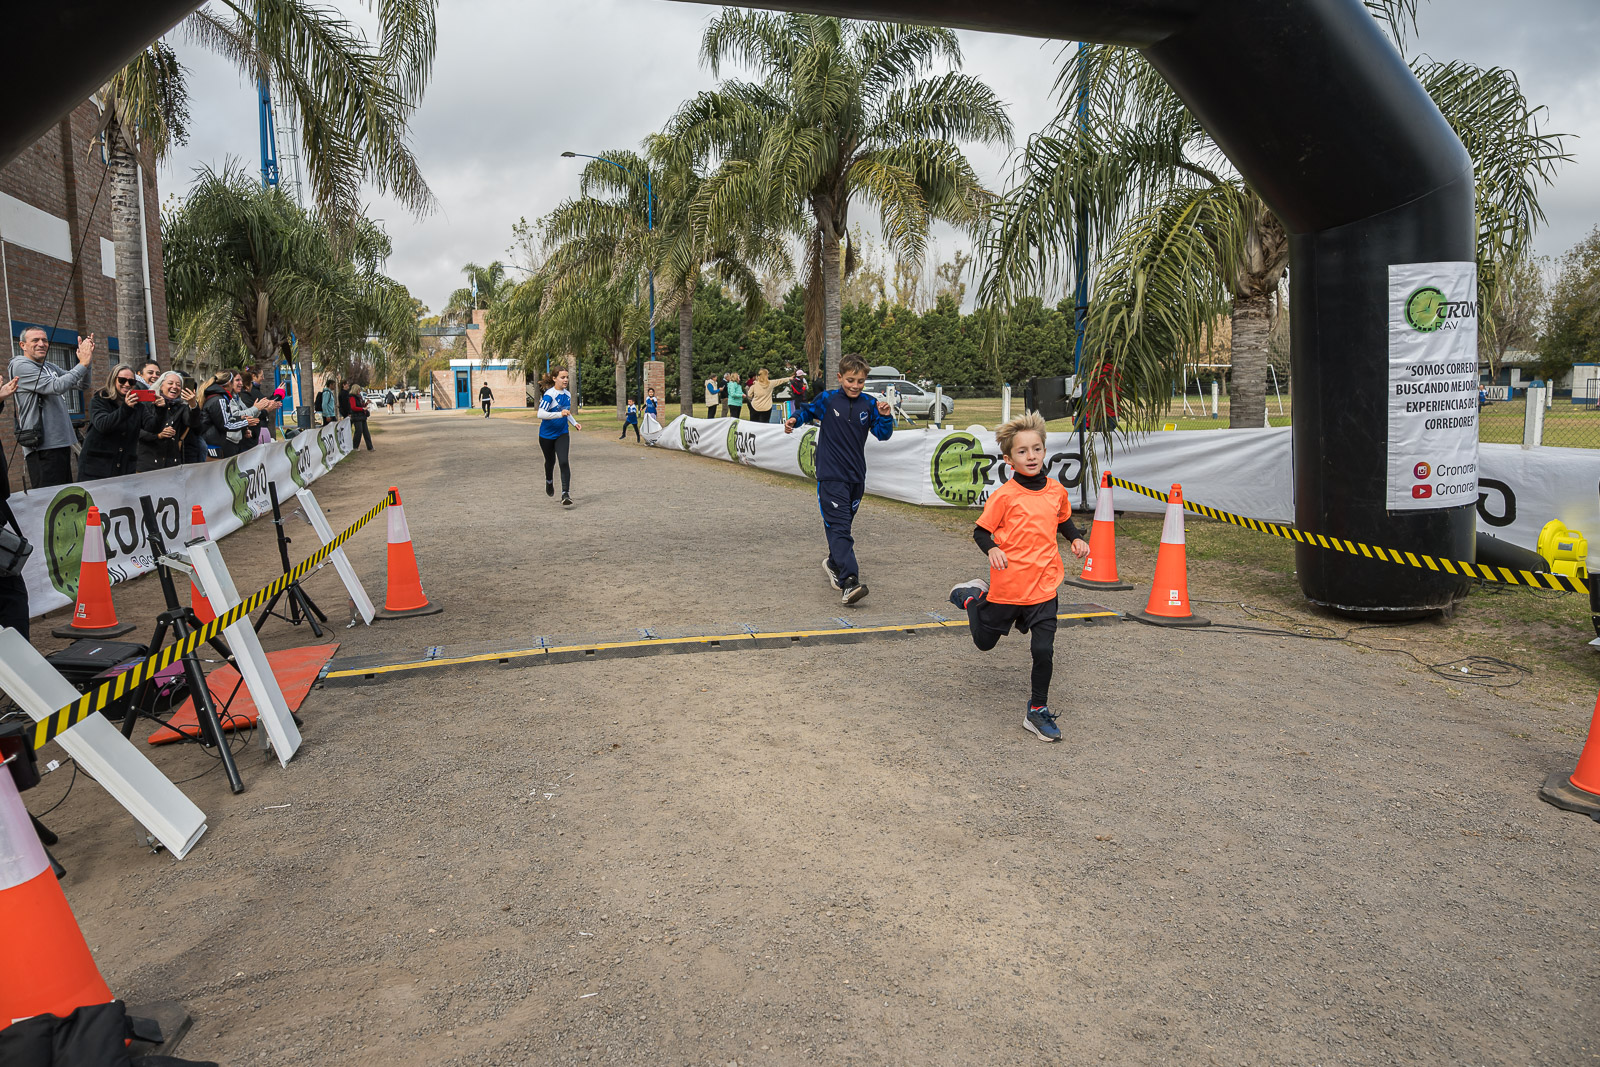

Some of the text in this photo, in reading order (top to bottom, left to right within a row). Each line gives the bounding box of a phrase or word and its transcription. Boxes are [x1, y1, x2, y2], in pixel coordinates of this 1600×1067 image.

[1435, 321, 1459, 331] RAV
[1396, 381, 1449, 395] BUSCANDO
[1486, 387, 1504, 399] ANO
[1406, 398, 1467, 413] EXPERIENCIAS
[1468, 398, 1474, 409] DE
